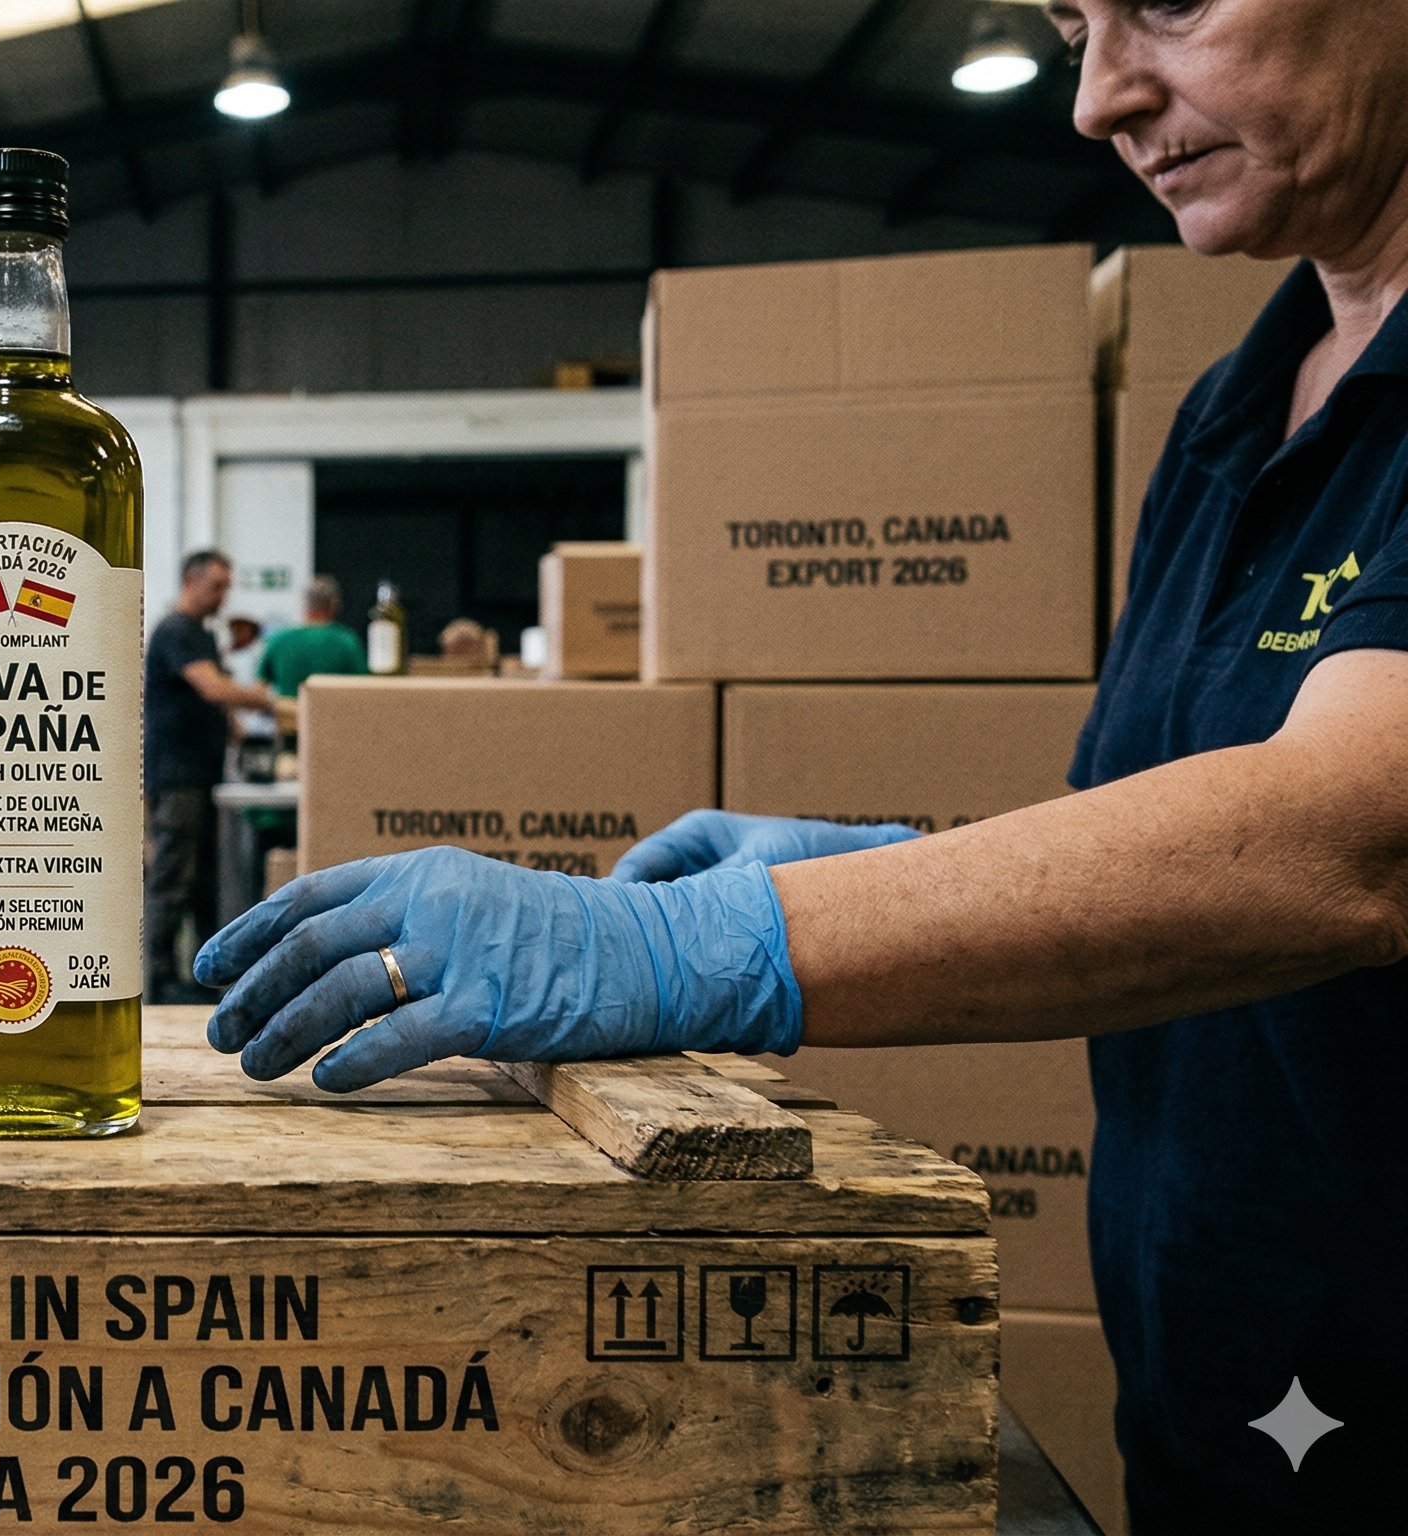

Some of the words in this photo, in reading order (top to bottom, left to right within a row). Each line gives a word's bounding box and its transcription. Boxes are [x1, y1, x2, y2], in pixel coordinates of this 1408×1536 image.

[729, 519, 873, 548] TORONTO,
[883, 515, 1010, 545] CANADA
[28, 557, 67, 580] 2026
[768, 558, 882, 587] EXPORT
[893, 557, 967, 586] 2026
[63, 671, 105, 700] DE
[11, 764, 66, 781] OLIVE
[73, 764, 102, 781] OIL
[7, 796, 27, 811] DE
[32, 796, 80, 811] OLIVA
[374, 810, 510, 841] TORONTO,
[520, 812, 638, 840] CANADA
[44, 857, 101, 873] VIRGIN
[9, 900, 83, 912] SELECTION
[20, 917, 83, 930] PREMIUM
[69, 970, 110, 989] JAÉN
[953, 1144, 1085, 1176] CANADA
[11, 1276, 79, 1340] IN
[106, 1275, 319, 1340] SPAIN
[129, 1366, 175, 1431] A
[201, 1351, 499, 1431] CANADÁ
[58, 1456, 244, 1522] 2026
